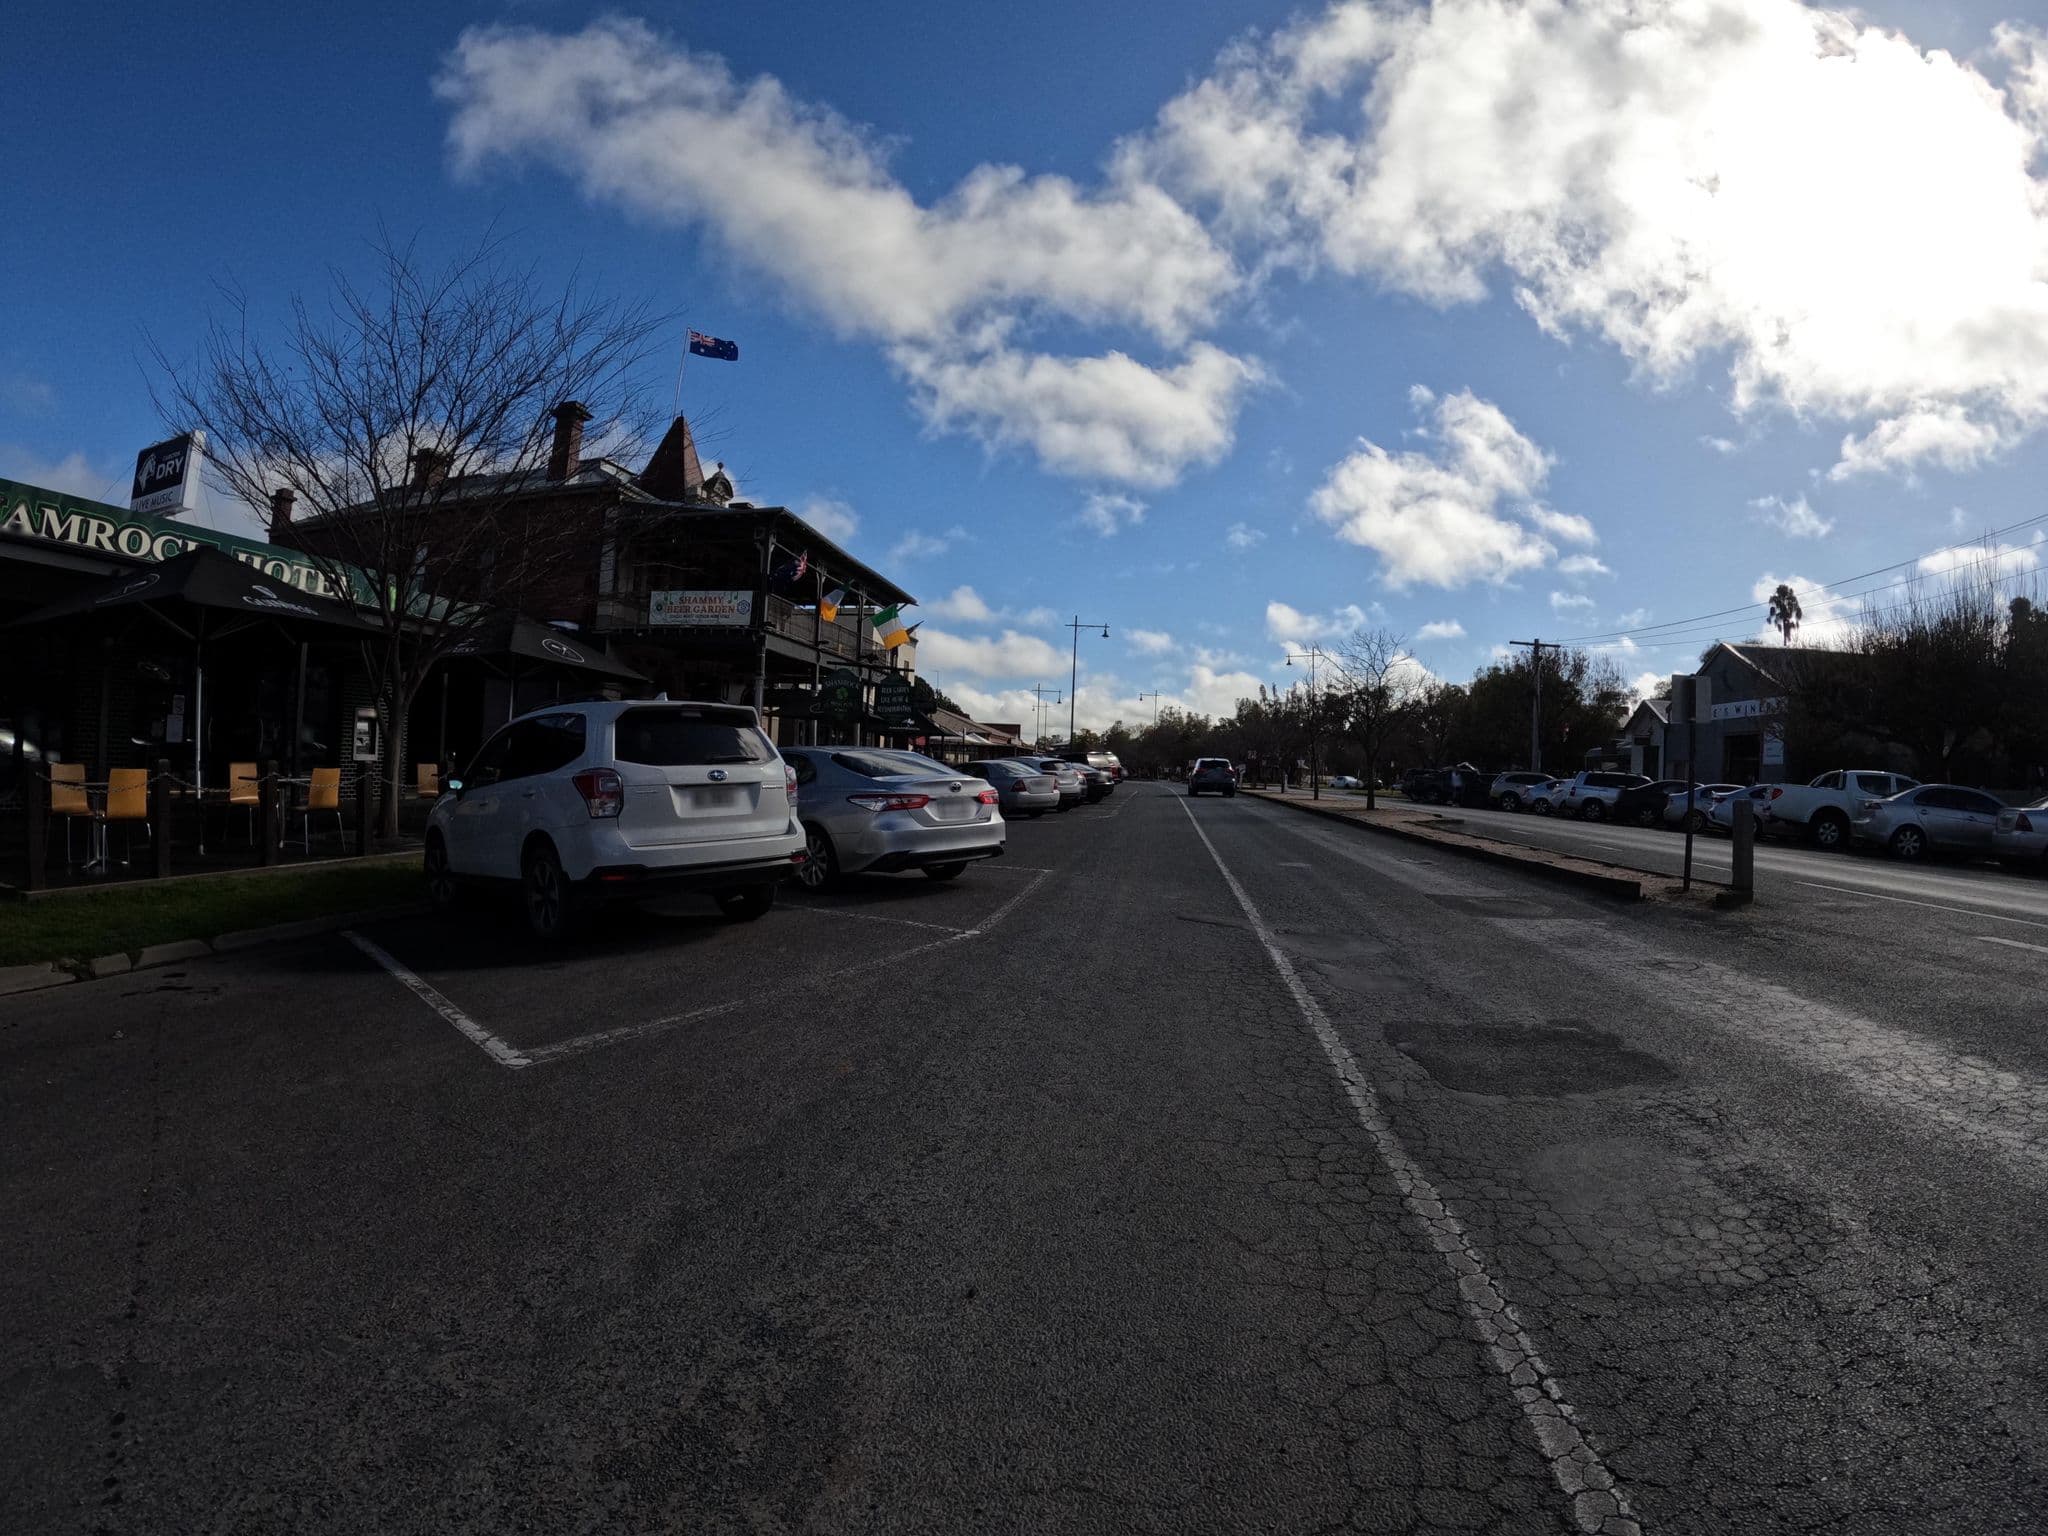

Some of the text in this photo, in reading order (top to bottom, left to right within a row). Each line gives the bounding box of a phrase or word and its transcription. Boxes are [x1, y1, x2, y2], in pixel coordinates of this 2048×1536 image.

[156, 456, 185, 480] DRY
[135, 491, 174, 511] LIVE MUSIC
[666, 604, 736, 614] BEER GARDEN
